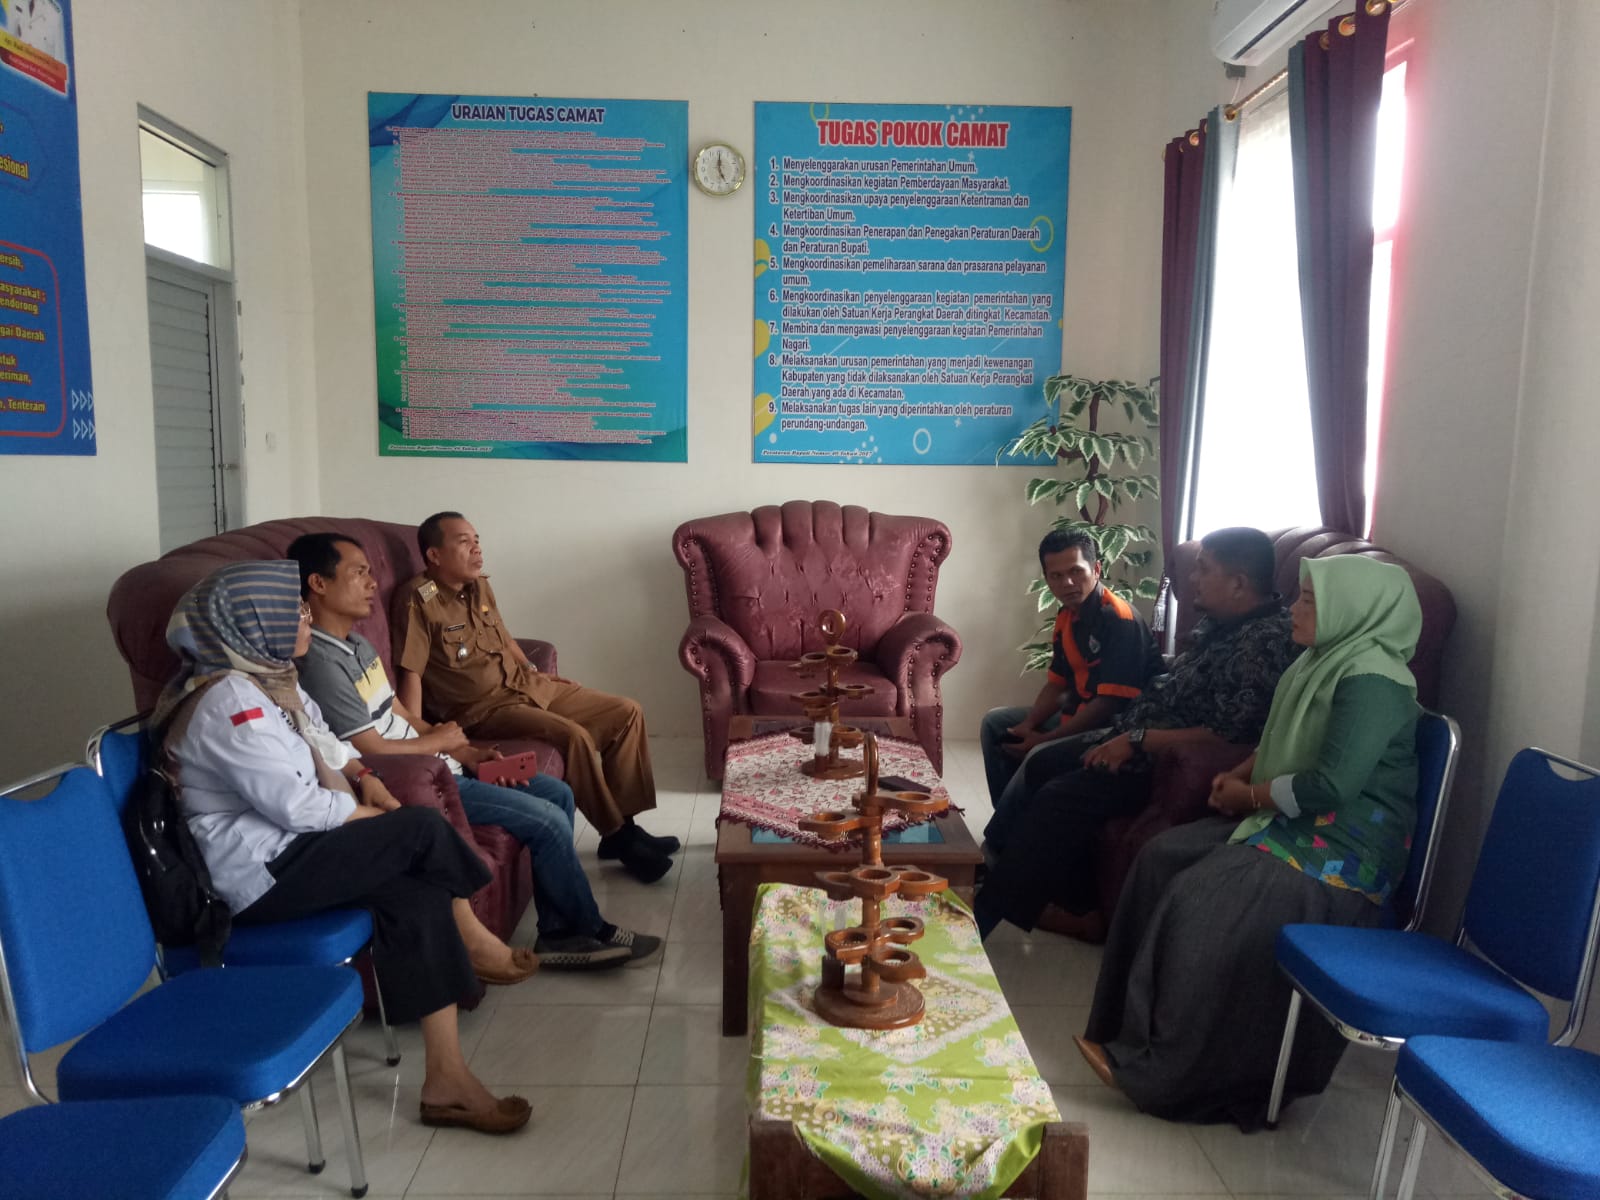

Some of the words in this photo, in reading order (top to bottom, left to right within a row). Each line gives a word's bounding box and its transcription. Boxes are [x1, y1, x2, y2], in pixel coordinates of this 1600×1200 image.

[451, 104, 506, 121] URAIAN
[508, 106, 554, 122] TUGAS
[558, 107, 605, 122] CAMAT
[817, 120, 877, 146] TUGAS
[881, 121, 942, 146] POKOK
[945, 122, 1009, 147] CAMAT
[770, 159, 778, 170] 1.
[784, 159, 858, 173] Menyelenggarakan
[861, 162, 888, 171] urusan
[891, 161, 946, 172] Pemerintahan
[949, 161, 976, 173] Umum.
[770, 176, 778, 187] 2.
[784, 176, 861, 190] Mengkoordinasikan
[864, 177, 898, 190] kegiatan
[901, 177, 959, 191] Pemberdayaan
[962, 178, 1009, 191] Masyarakat.
[770, 191, 778, 203] 3.
[784, 192, 861, 206] Mengkoordinasikan
[864, 195, 887, 206] upaya
[890, 193, 958, 207] penyelenggaraan
[961, 194, 1011, 206] Ketentraman
[1014, 195, 1028, 206] dan
[783, 209, 824, 220] Ketertiban
[827, 209, 855, 220] Umum.
[770, 225, 778, 236] 4.
[783, 225, 860, 239] Mengkoordinasikan
[864, 226, 905, 240] Penerapan
[908, 227, 922, 238] dan
[925, 227, 968, 240] Penegakan
[971, 227, 1009, 239] Peraturan
[1012, 228, 1039, 239] Daerah
[783, 242, 797, 253] dan
[800, 242, 838, 253] Peraturan
[841, 243, 869, 256] Bupati.
[770, 258, 778, 269] 5.
[783, 258, 860, 272] Mengkoordinasikan
[863, 259, 915, 273] pemeliharaan
[918, 261, 944, 271] sarana
[947, 259, 961, 271] dan
[964, 262, 1003, 273] prasarana
[1006, 260, 1045, 274] pelayanan
[783, 277, 809, 285] umum.
[770, 291, 778, 301] 6.
[783, 291, 859, 304] Mengkoordinasikan
[864, 292, 931, 305] penyelenggaraan
[937, 292, 969, 305] kegiatan
[974, 293, 1027, 306] pemerintahan
[1032, 295, 1050, 306] yang
[783, 307, 820, 318] dilakukan
[823, 307, 839, 318] oleh
[842, 308, 869, 318] Satuan
[872, 308, 892, 321] Kerja
[895, 308, 933, 321] Perangkat
[936, 308, 963, 319] Daerah
[966, 308, 1000, 322] ditingkat
[1005, 309, 1050, 320] Kecamatan.
[769, 323, 778, 334] 7.
[782, 323, 818, 334] Membina
[821, 324, 834, 335] dan
[837, 324, 881, 337] mengawasi
[884, 324, 950, 338] penyelenggaraan
[953, 325, 985, 338] kegiatan
[989, 325, 1042, 336] Pemerintahan
[782, 339, 810, 352] Nagari.
[769, 355, 777, 366] 8.
[782, 355, 837, 367] Melaksanakan
[841, 358, 867, 367] urusan
[871, 356, 924, 369] pemerintahan
[928, 359, 946, 370] yang
[950, 357, 980, 370] menjadi
[984, 357, 1032, 370] kewenangan
[782, 371, 823, 384] Kabupaten
[826, 374, 845, 384] yang
[848, 372, 866, 382] tidak
[869, 372, 919, 383] dilaksanakan
[922, 372, 938, 383] oleh
[941, 372, 967, 383] Satuan
[970, 373, 990, 386] Kerja
[993, 373, 1032, 386] Perangkat
[782, 388, 809, 398] Daerah
[812, 390, 830, 400] yang
[832, 388, 846, 398] ada
[849, 388, 856, 398] di
[859, 388, 904, 399] Kecamatan.
[769, 403, 776, 413] 9.
[782, 403, 836, 414] Melaksanakan
[839, 403, 860, 416] tugas
[863, 404, 876, 414] lain
[879, 406, 897, 417] yang
[900, 404, 952, 417] diperintahkan
[955, 405, 971, 415] oleh
[974, 405, 1011, 418] peraturan
[782, 420, 866, 432] perundang-undangan.
